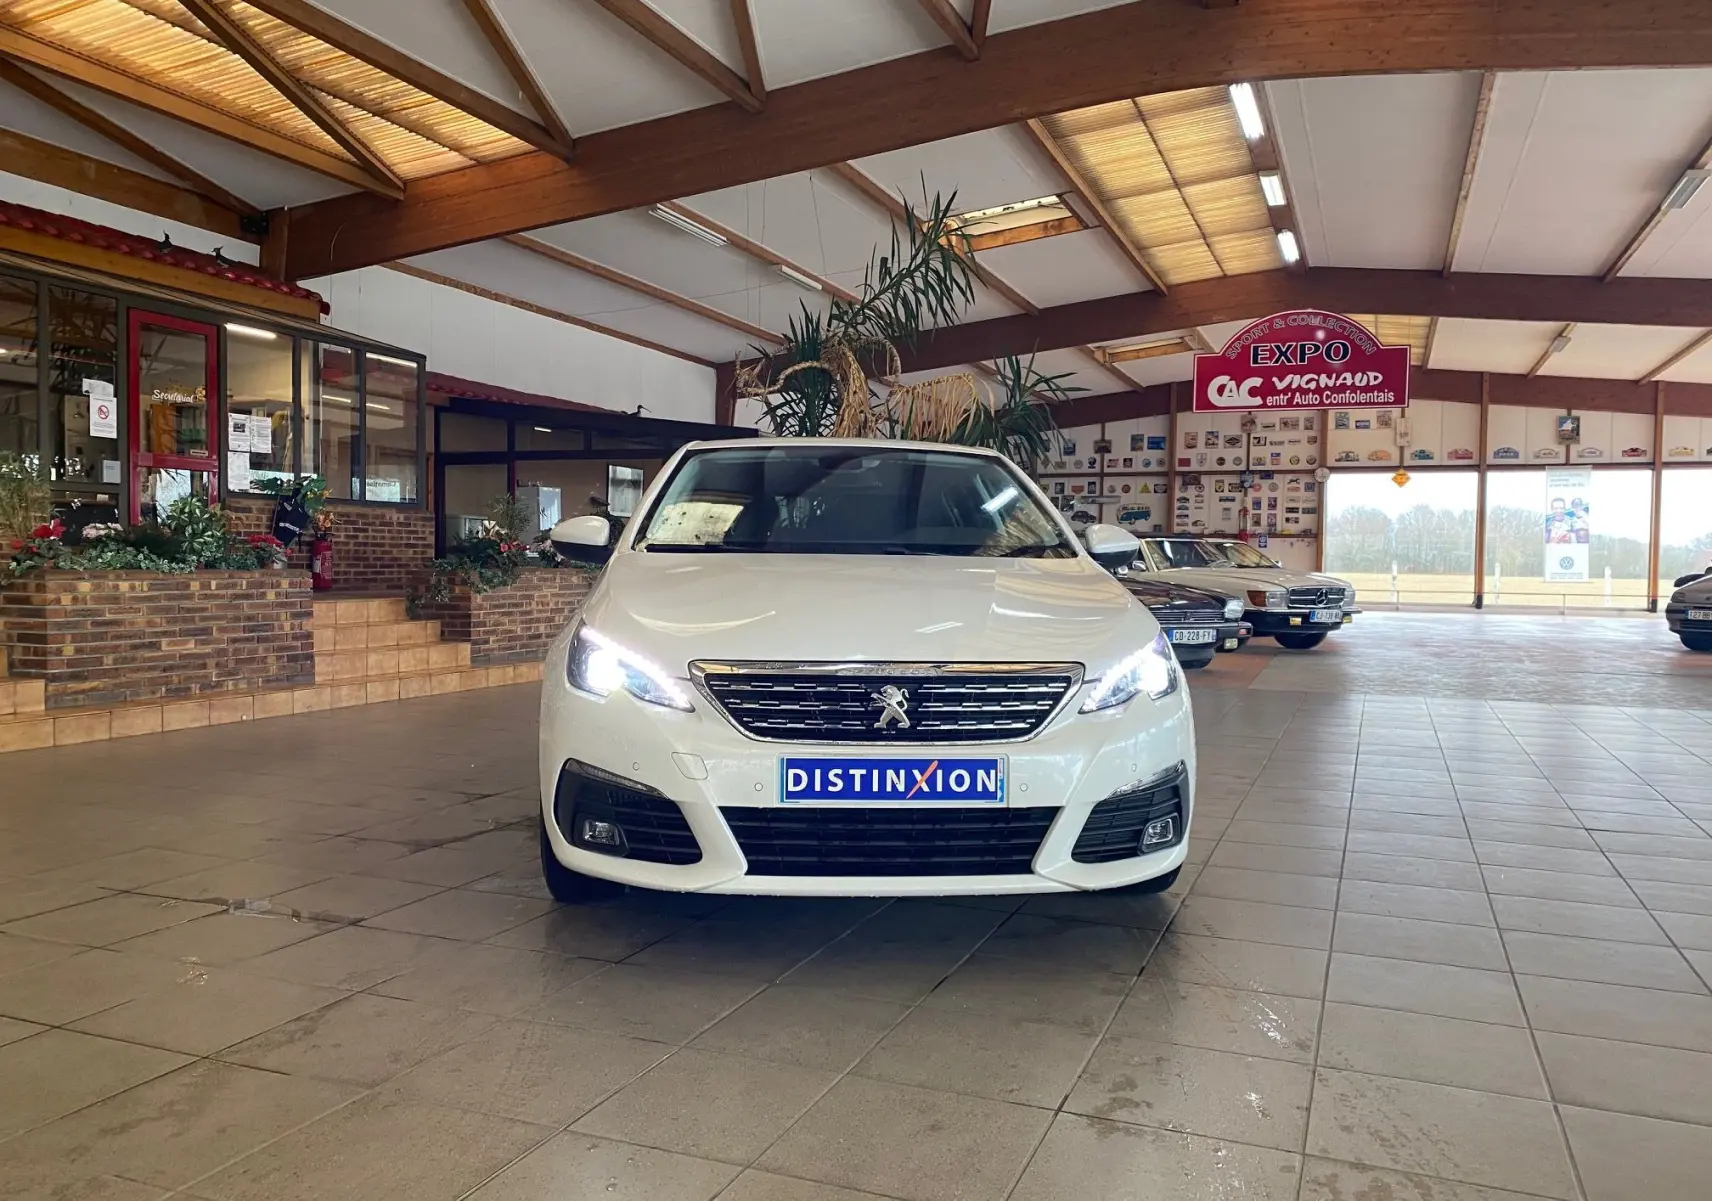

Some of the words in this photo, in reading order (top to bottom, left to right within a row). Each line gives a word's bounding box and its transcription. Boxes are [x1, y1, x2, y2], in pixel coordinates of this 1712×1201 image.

[1226, 323, 1269, 360] SPORT
[1273, 318, 1285, 329] &
[1287, 314, 1377, 355] COLLECTION
[1250, 340, 1351, 366] EXPO
[1207, 375, 1263, 407] CAC
[1272, 371, 1383, 390] VIGNAUD
[1293, 391, 1320, 405] Auto
[1323, 389, 1395, 404] Confolentais
[1175, 631, 1211, 641] CD-228-FY
[787, 763, 996, 798] DISTINXION
